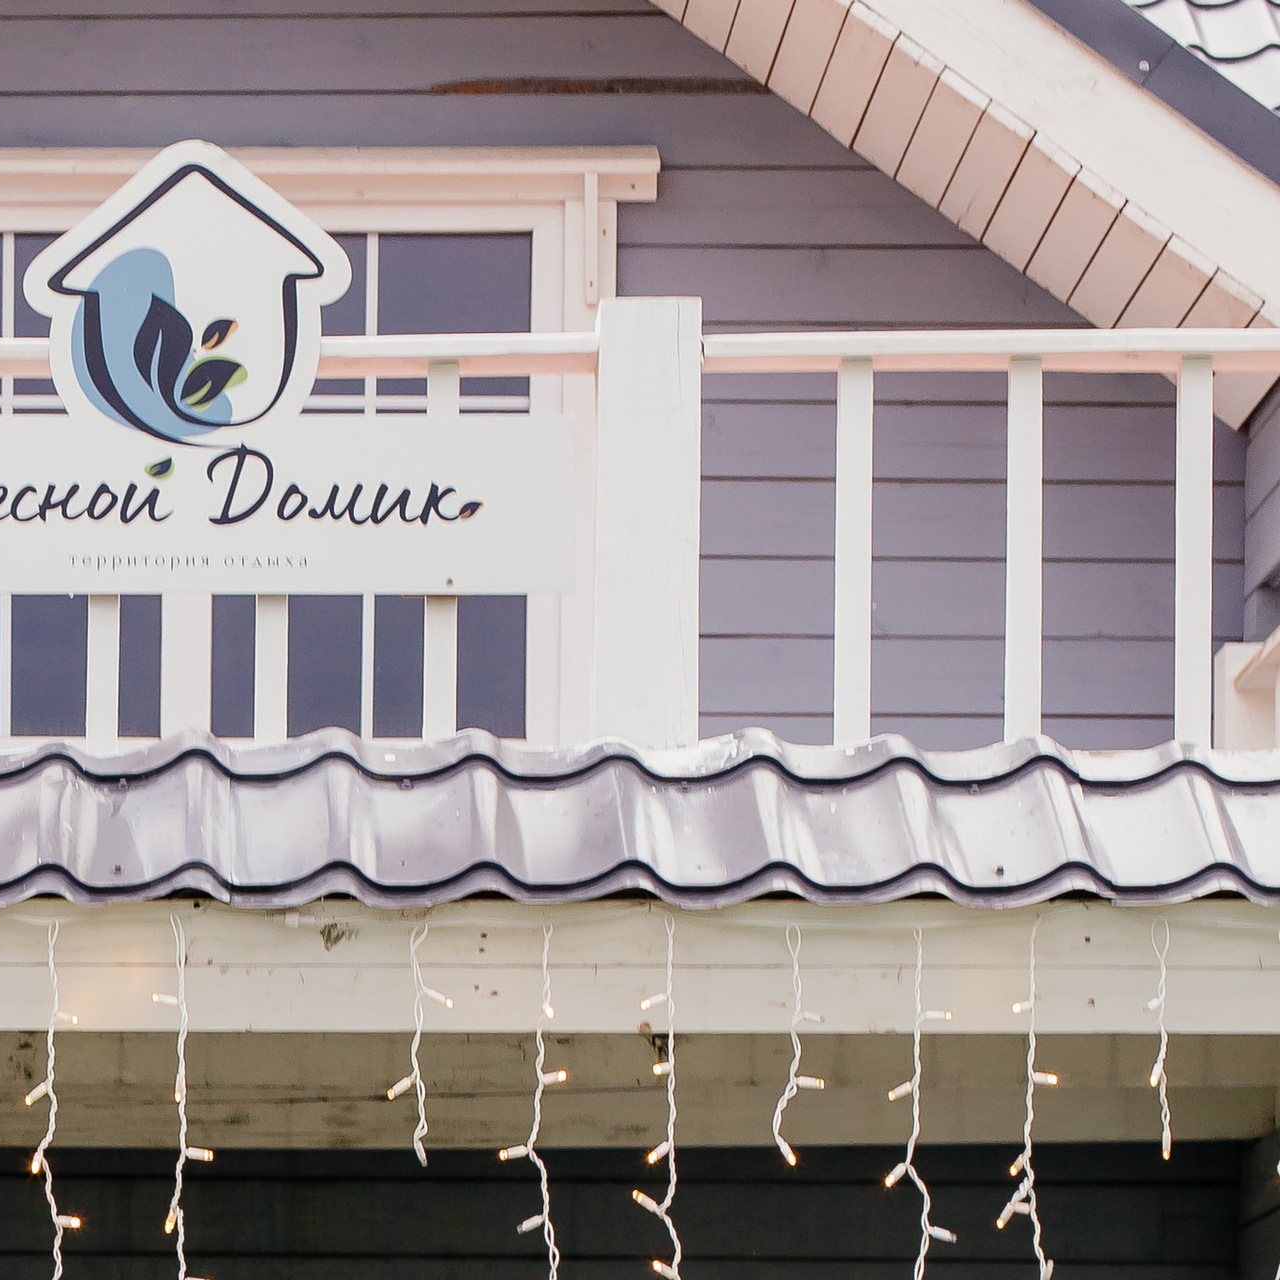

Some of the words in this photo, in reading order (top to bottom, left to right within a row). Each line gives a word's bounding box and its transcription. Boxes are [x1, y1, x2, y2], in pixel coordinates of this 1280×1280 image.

[206, 442, 466, 526] Домик
[69, 553, 210, 571] территория
[222, 554, 308, 569] отдыха
